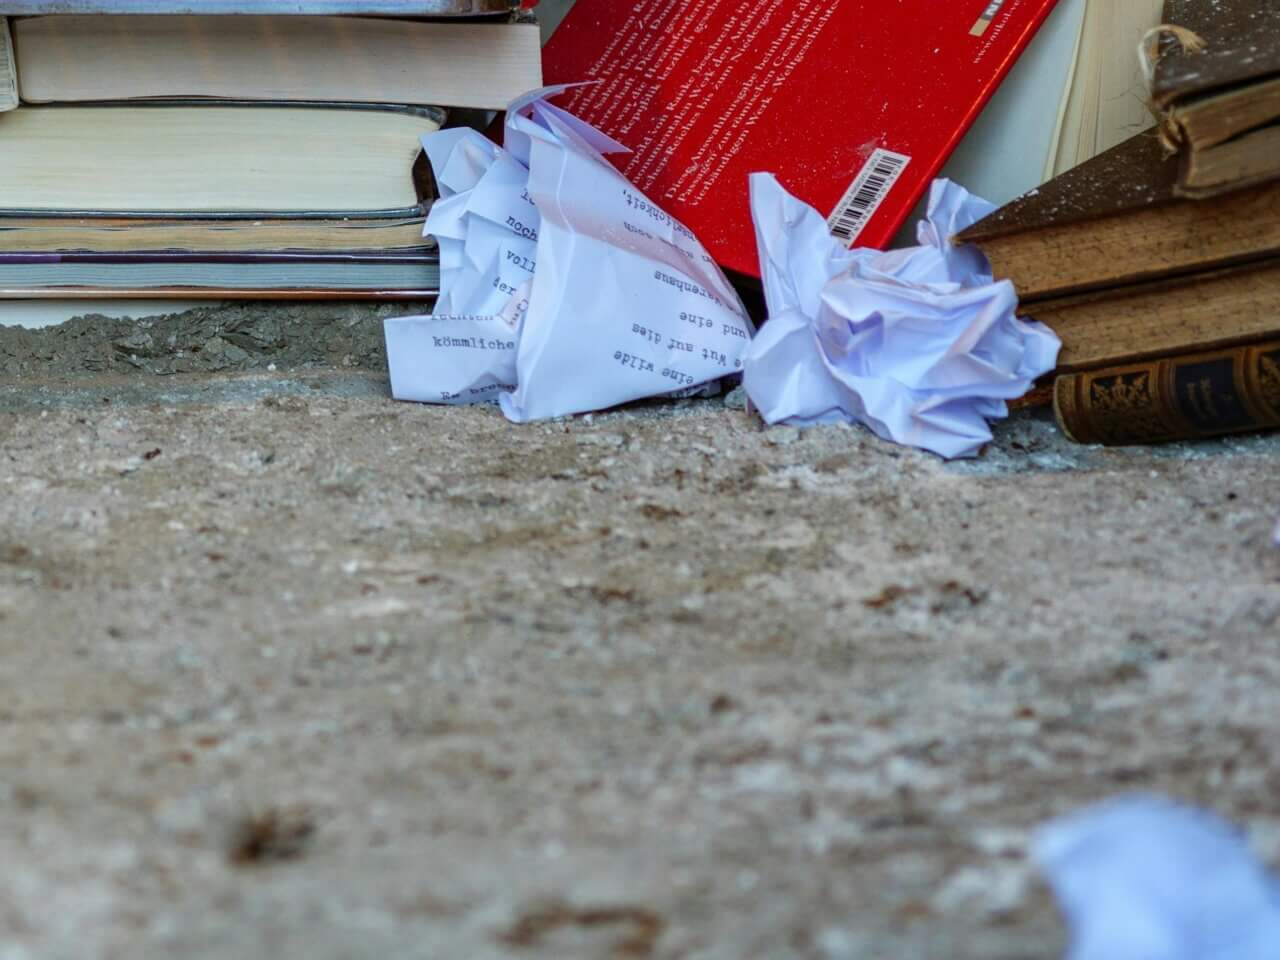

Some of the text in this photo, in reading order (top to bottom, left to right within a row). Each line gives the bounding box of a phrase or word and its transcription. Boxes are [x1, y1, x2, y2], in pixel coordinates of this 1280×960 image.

[584, 15, 636, 76] Römischen
[601, 59, 620, 75] bis
[619, 31, 639, 57] zum
[633, 35, 665, 71] Dieses
[592, 72, 625, 110] Sahara
[620, 53, 638, 70] bis
[637, 31, 652, 52] zur
[619, 83, 662, 134] Republik
[656, 35, 695, 81] letztlich
[619, 136, 656, 176] eopold
[649, 114, 669, 134] von
[665, 75, 695, 111] Ranke
[690, 15, 738, 75] beschreibt
[735, 1, 749, 14] in
[688, 67, 716, 99] Werk
[709, 45, 732, 68] den
[615, 101, 635, 121] war
[631, 81, 647, 100] die
[663, 166, 693, 199] Diese
[690, 72, 758, 165] Auswahlausgabe
[753, 10, 800, 70] beinhaltet
[664, 111, 701, 155] Reiches
[695, 92, 714, 109] bis
[712, 65, 734, 90] zum
[676, 149, 718, 202] Passagen
[717, 130, 732, 150] zur
[730, 69, 776, 128] römischen
[772, 3, 822, 67] Geschichte
[688, 127, 750, 206] vierbändigem
[744, 96, 773, 126] Werk
[504, 214, 537, 241] noch
[432, 335, 515, 349] kömmliche
[631, 323, 662, 345] dies
[667, 338, 694, 353] auf
[680, 311, 747, 339] und eine
[613, 349, 695, 386] eine wilde
[702, 348, 727, 367] Wut
